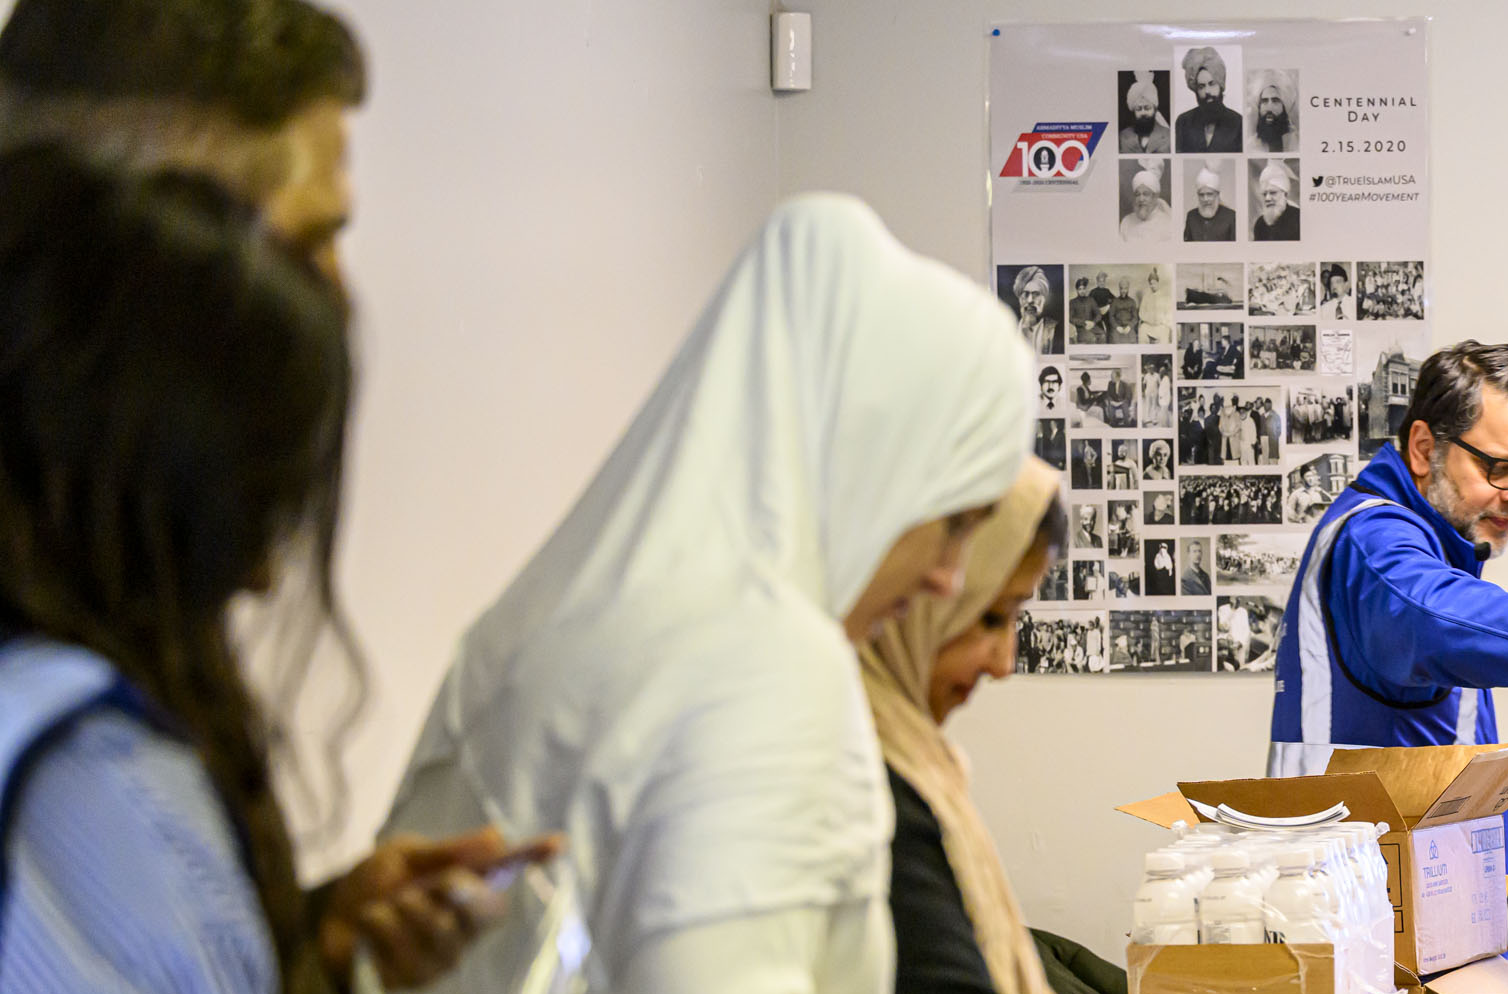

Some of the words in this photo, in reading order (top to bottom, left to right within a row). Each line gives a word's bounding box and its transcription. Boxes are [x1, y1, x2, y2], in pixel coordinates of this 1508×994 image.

[1310, 96, 1417, 108] CENTENNIAL
[1347, 111, 1380, 123] DAY
[1321, 140, 1406, 153] 2.15.2020
[1016, 139, 1090, 179] 100
